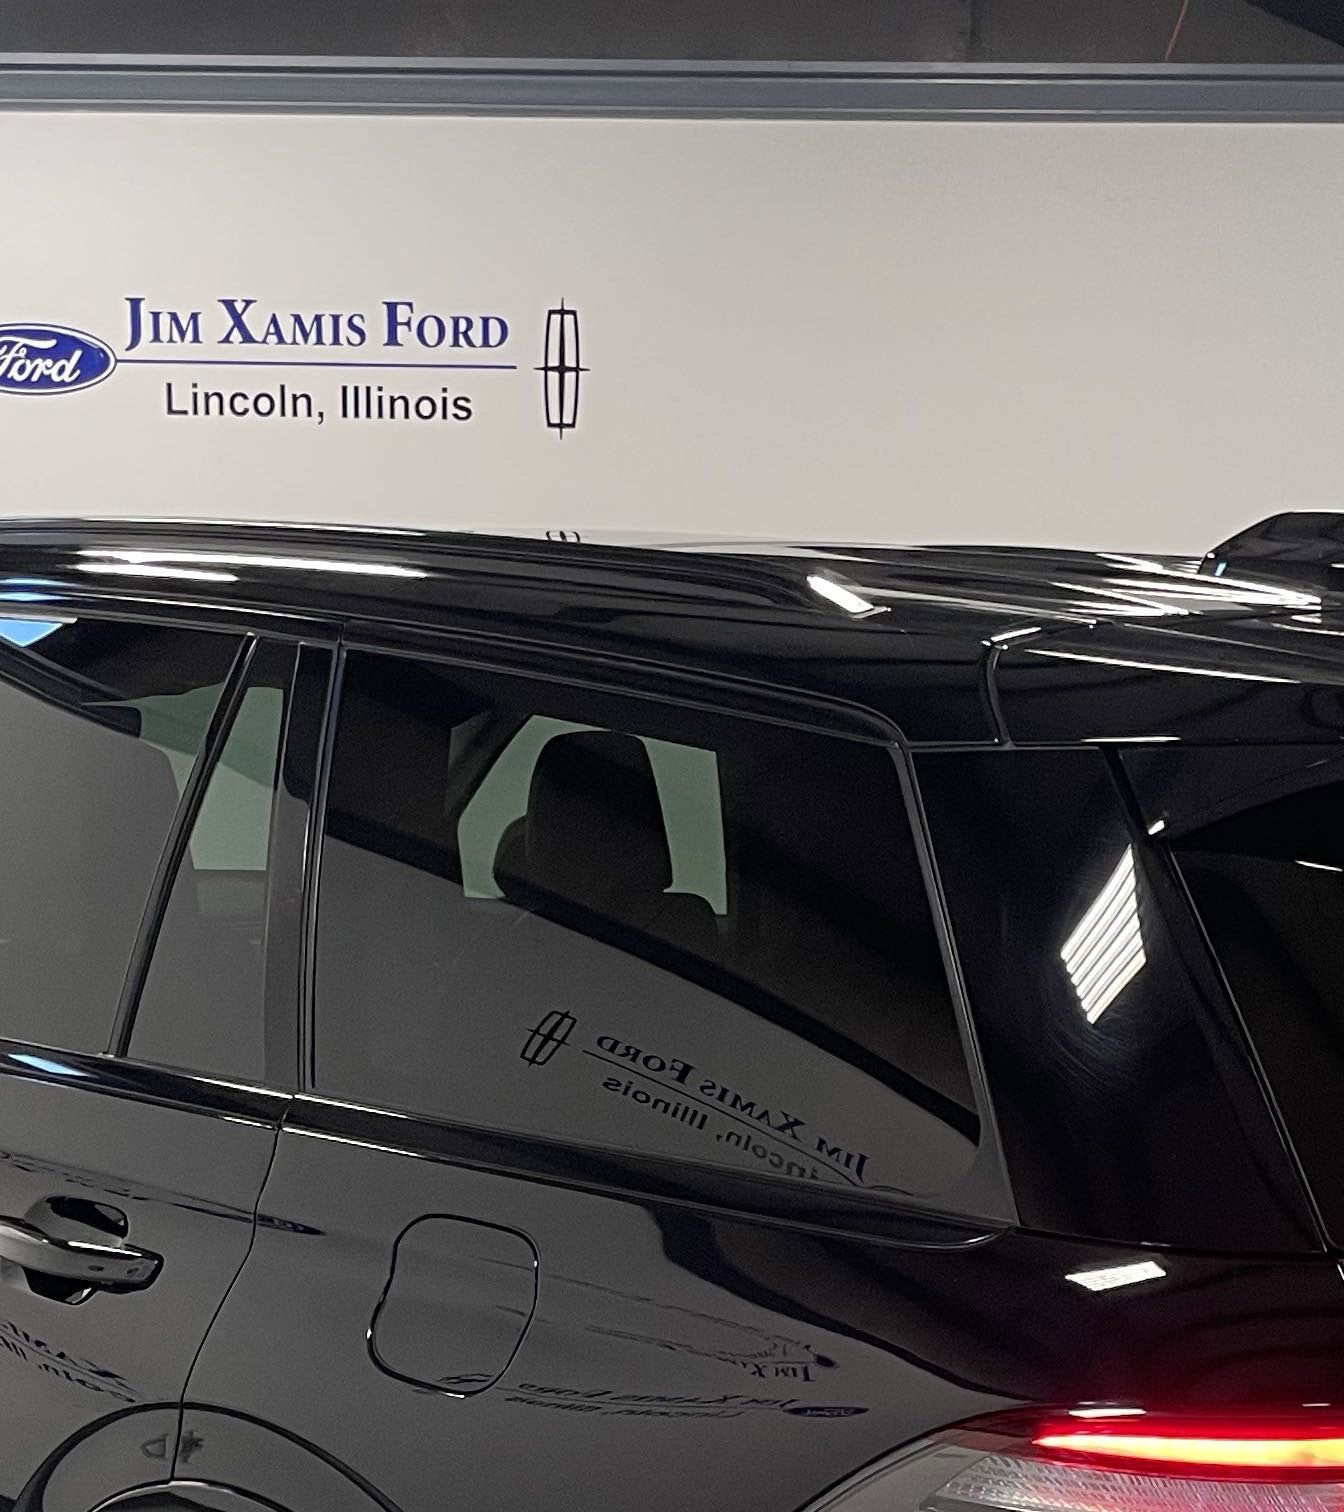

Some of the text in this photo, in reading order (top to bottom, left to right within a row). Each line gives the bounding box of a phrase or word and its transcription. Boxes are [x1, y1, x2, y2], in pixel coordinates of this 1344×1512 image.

[124, 297, 510, 352] JIM XAMIS FORD
[164, 382, 473, 425] Lincoln, Illinois
